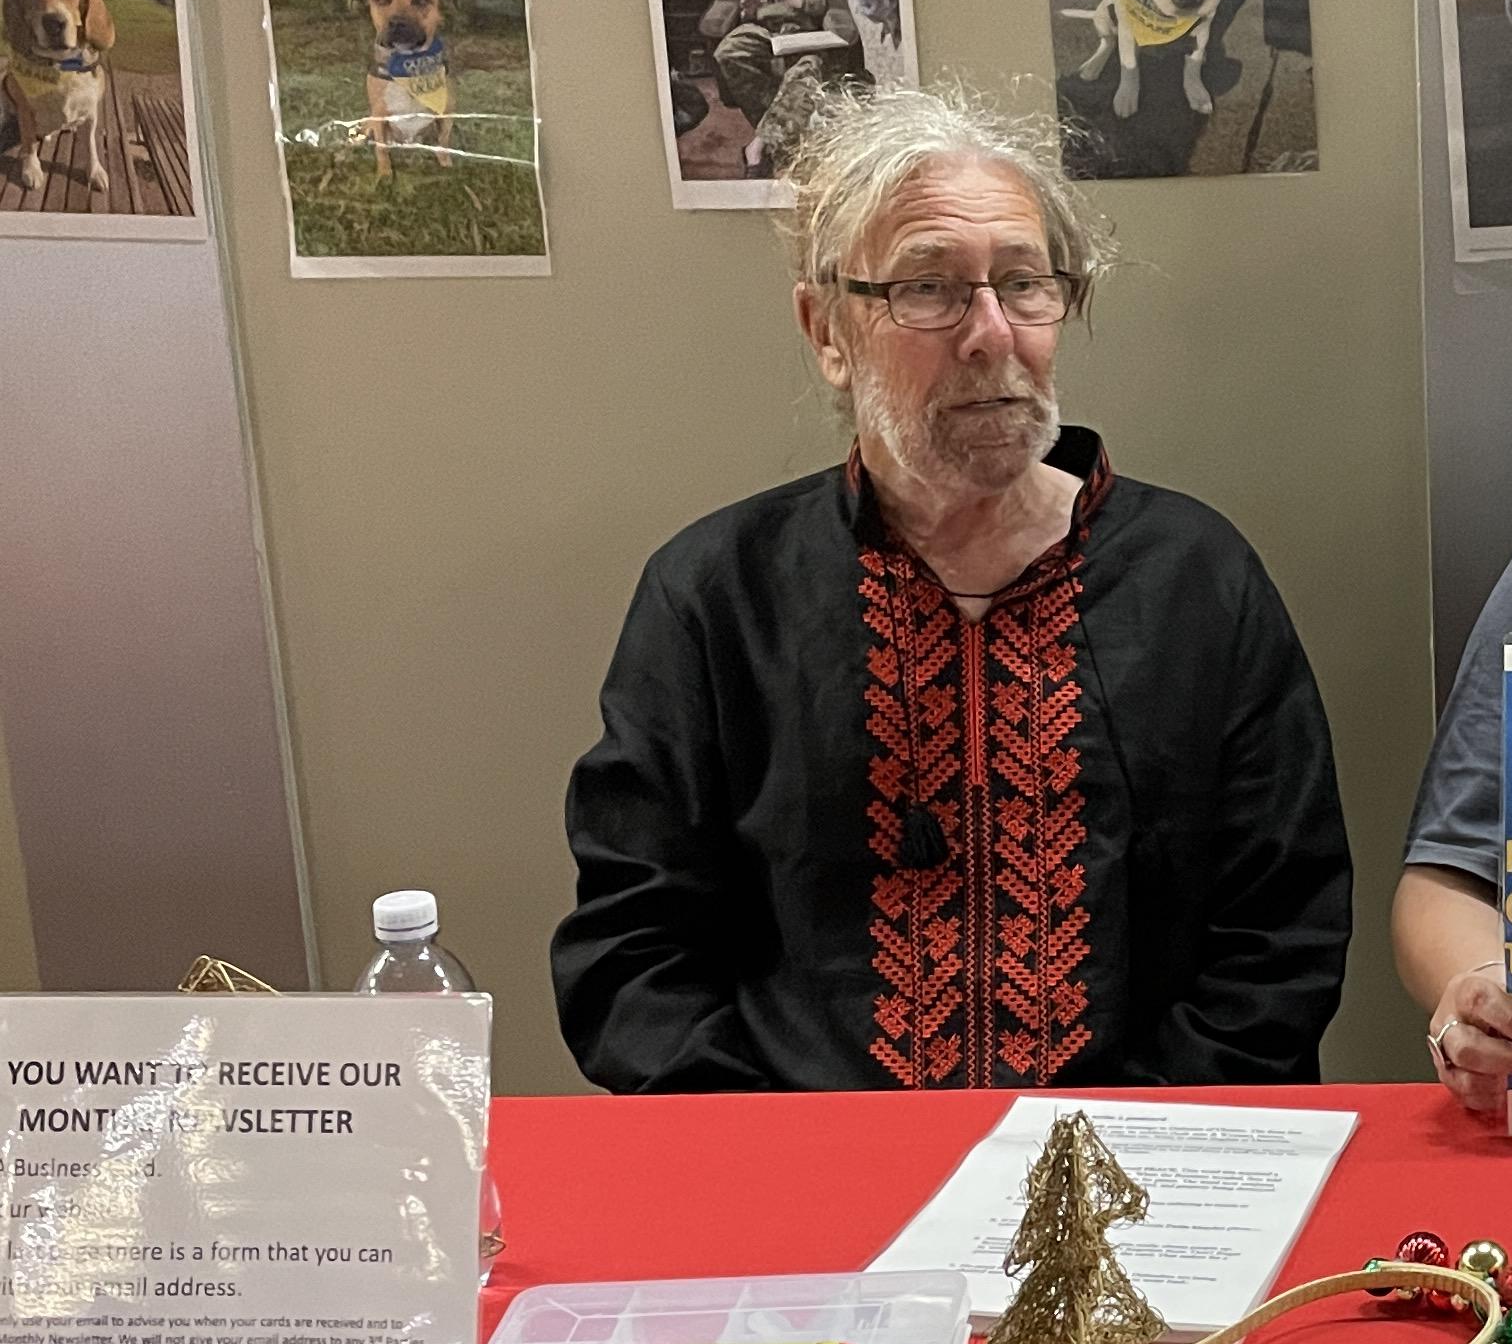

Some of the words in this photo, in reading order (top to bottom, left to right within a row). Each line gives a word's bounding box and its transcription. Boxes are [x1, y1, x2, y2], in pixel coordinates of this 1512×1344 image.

[8, 1061, 65, 1086] YOU
[75, 1061, 162, 1086] WANT
[219, 1062, 331, 1086] RECEIVE
[340, 1062, 402, 1087] OUR
[170, 1242, 186, 1261] is
[192, 1246, 203, 1261] a
[211, 1241, 260, 1262] form
[268, 1242, 309, 1262] that
[314, 1246, 351, 1266] you
[358, 1248, 393, 1263] can
[154, 1277, 242, 1297] address.
